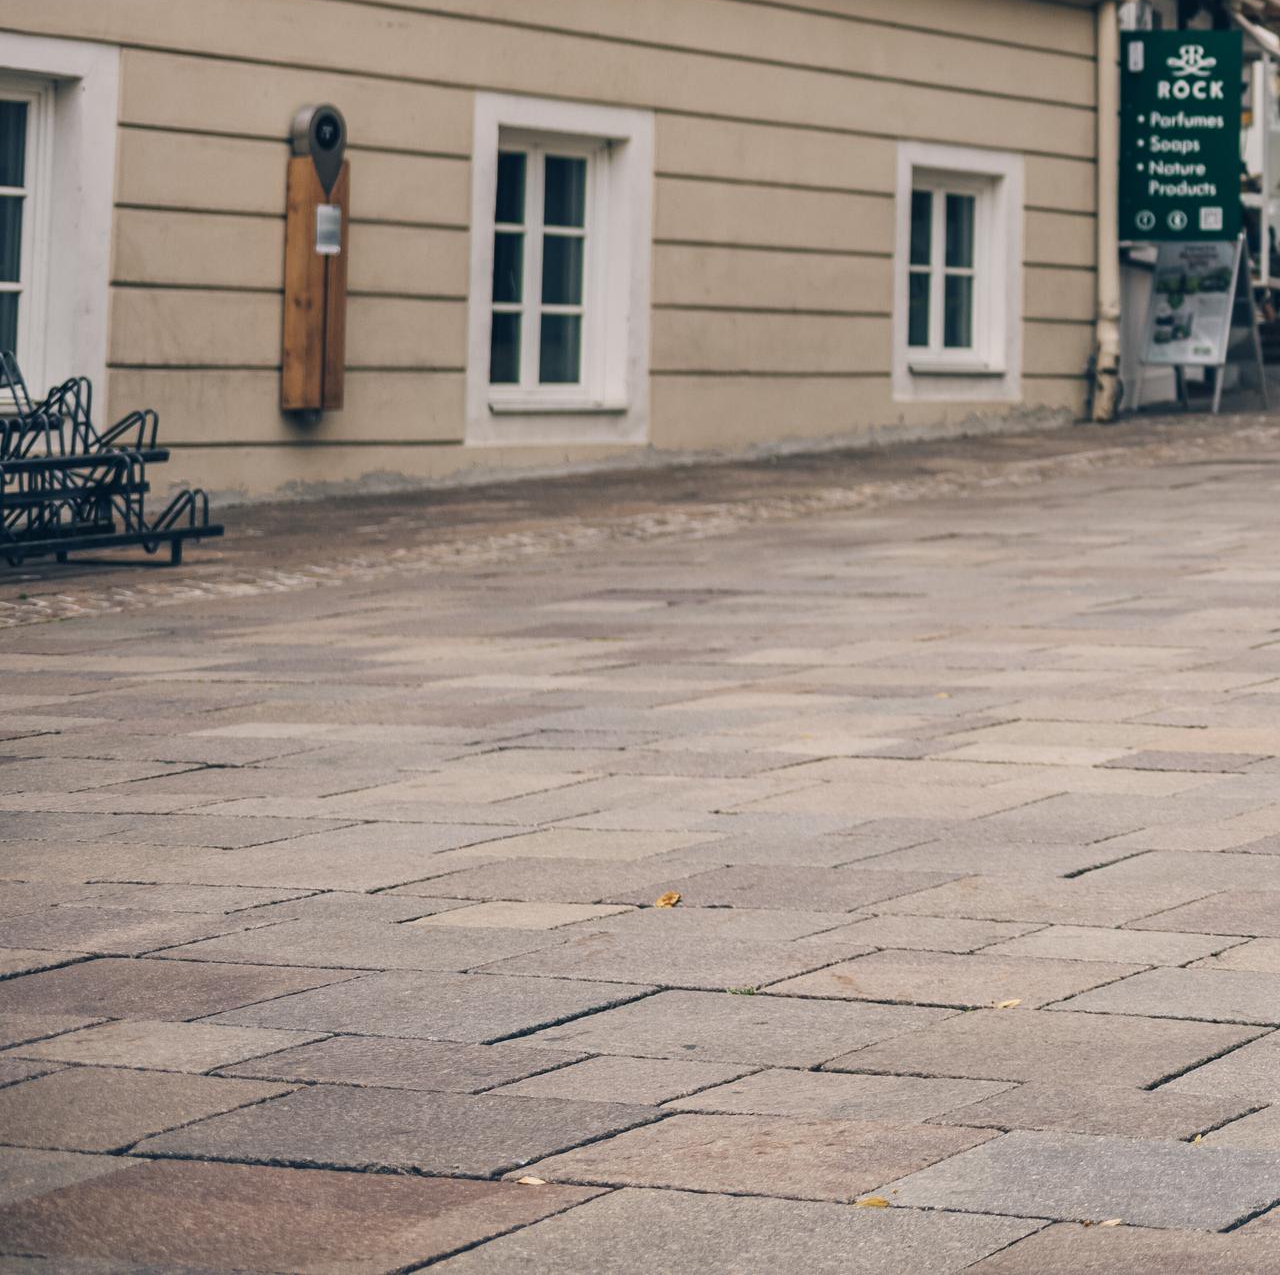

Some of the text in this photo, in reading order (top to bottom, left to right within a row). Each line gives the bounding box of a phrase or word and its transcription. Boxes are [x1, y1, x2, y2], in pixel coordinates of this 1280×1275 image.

[1157, 79, 1224, 100] ROCK
[1150, 111, 1224, 129] Parfumes
[1149, 134, 1200, 156] Soaps
[1148, 160, 1206, 177] Nature
[1148, 180, 1217, 197] Products
